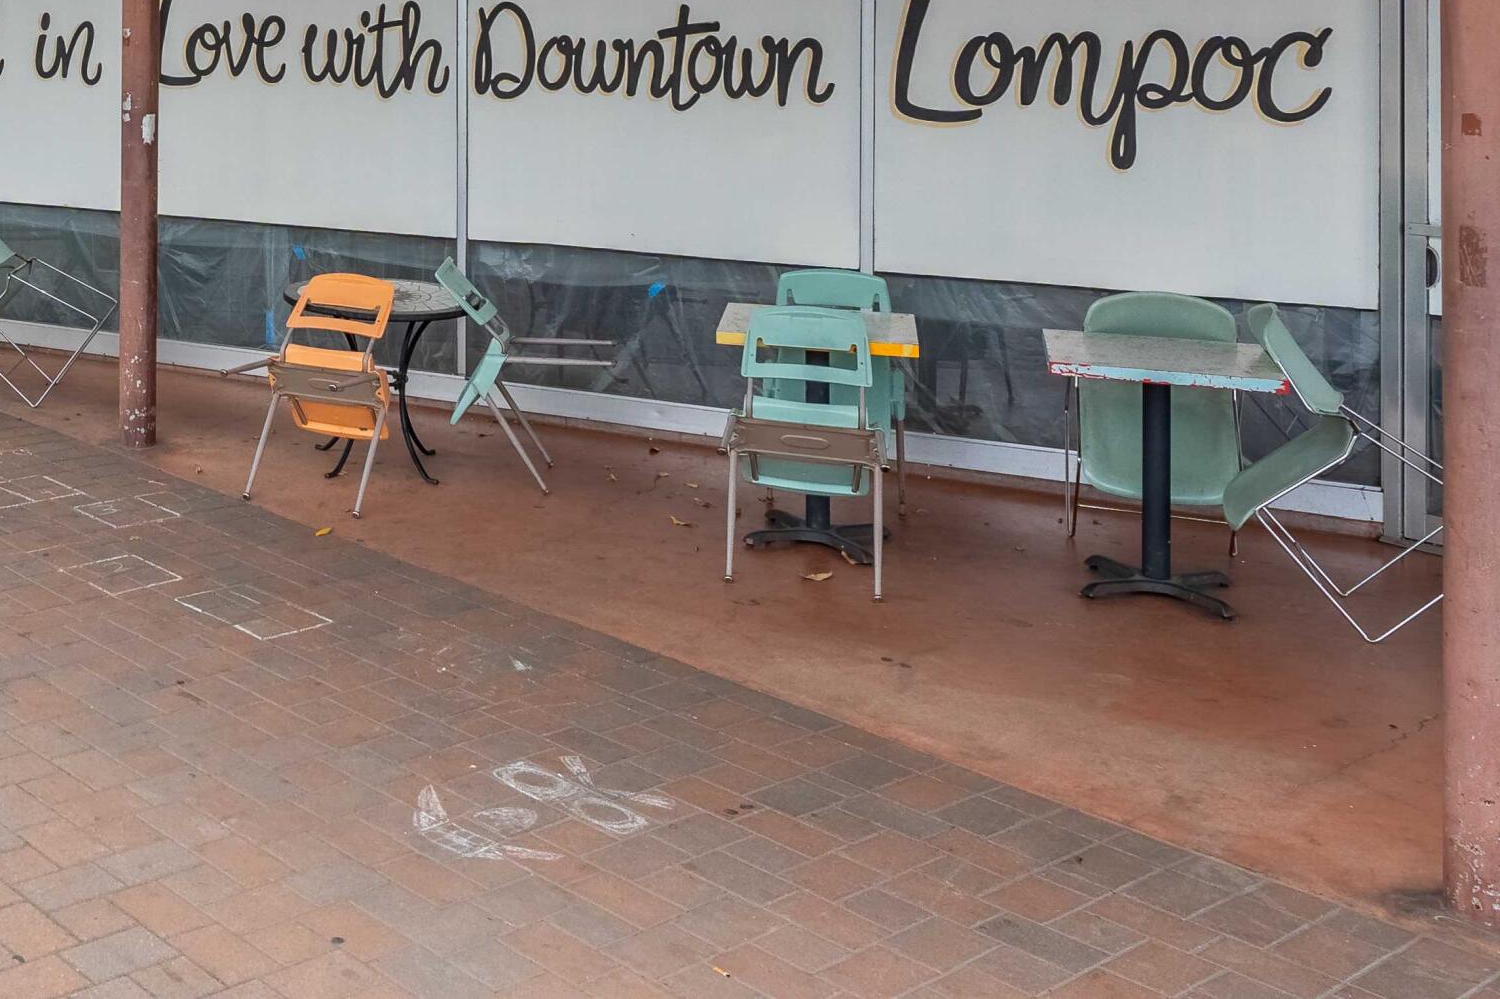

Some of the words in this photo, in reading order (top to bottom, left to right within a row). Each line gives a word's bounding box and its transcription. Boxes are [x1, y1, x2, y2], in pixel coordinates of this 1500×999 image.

[34, 11, 103, 87] in
[301, 0, 450, 100] with
[474, 0, 836, 112] Downtown
